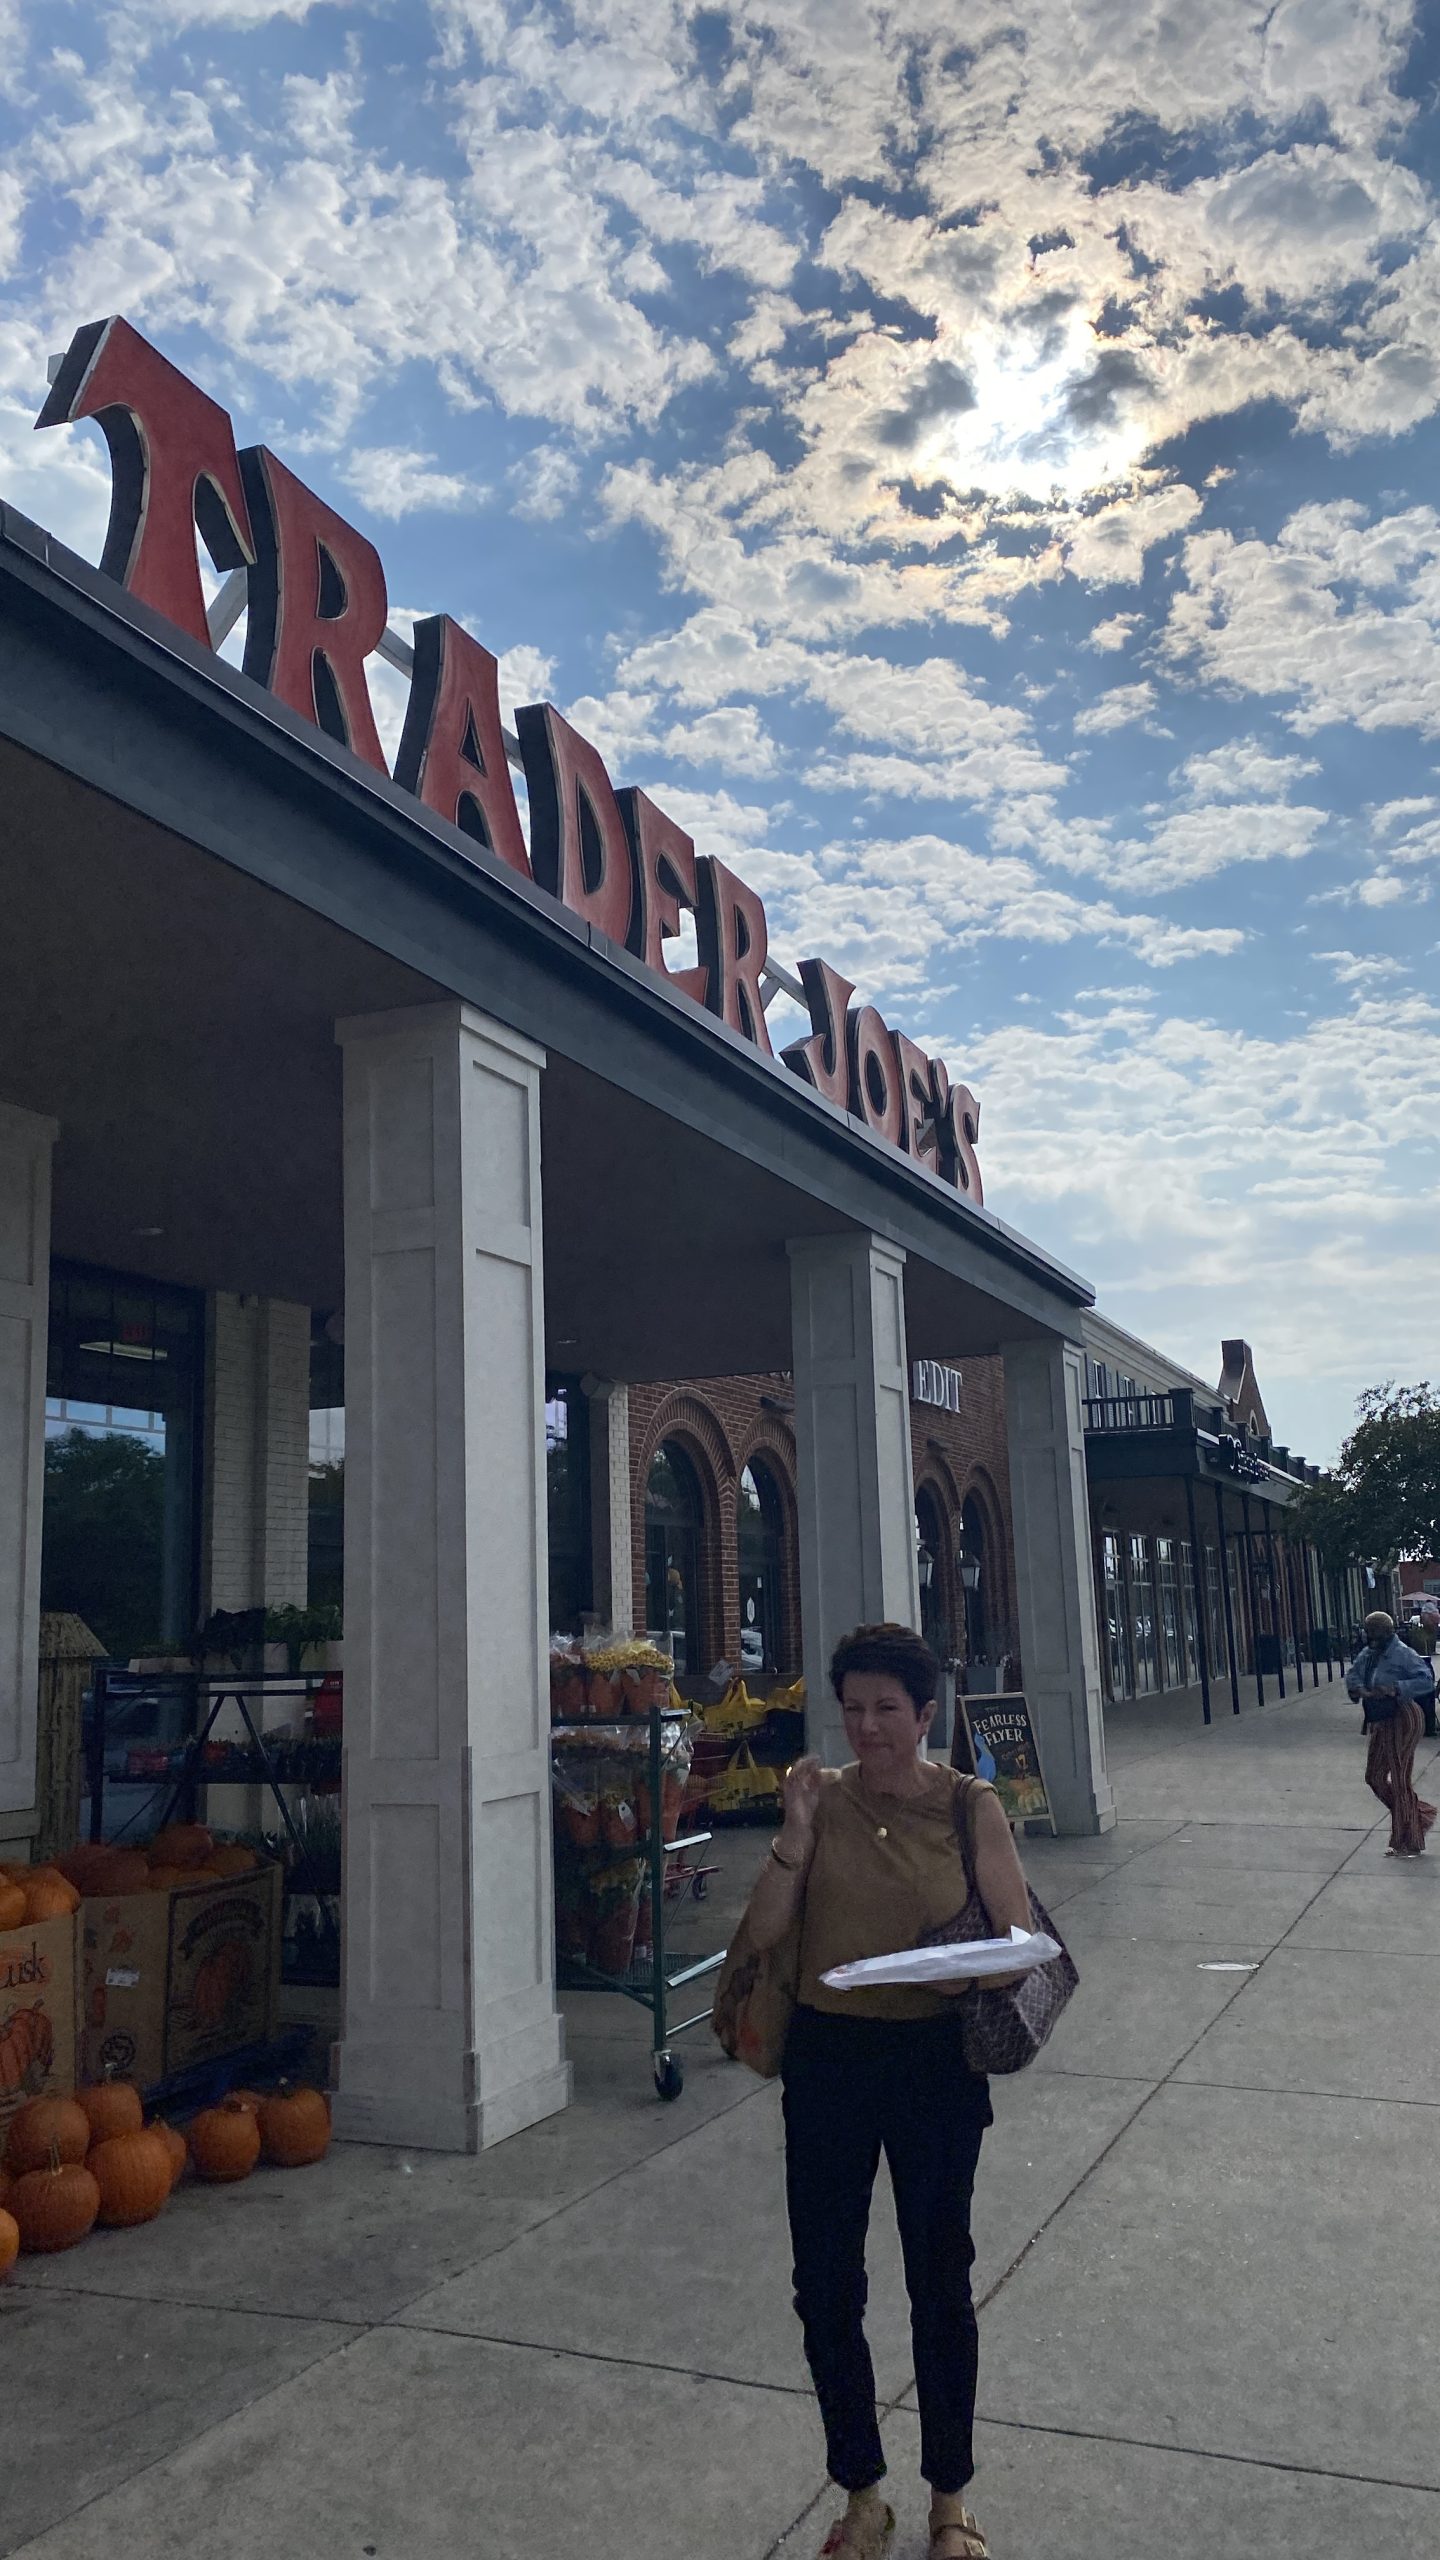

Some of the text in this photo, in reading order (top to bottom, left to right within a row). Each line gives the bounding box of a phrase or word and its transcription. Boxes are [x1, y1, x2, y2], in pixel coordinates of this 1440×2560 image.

[36, 314, 984, 1206] TRADER JOE'S
[972, 1714, 1027, 1734] FEARLESS
[983, 1728, 1024, 1747] FLYER
